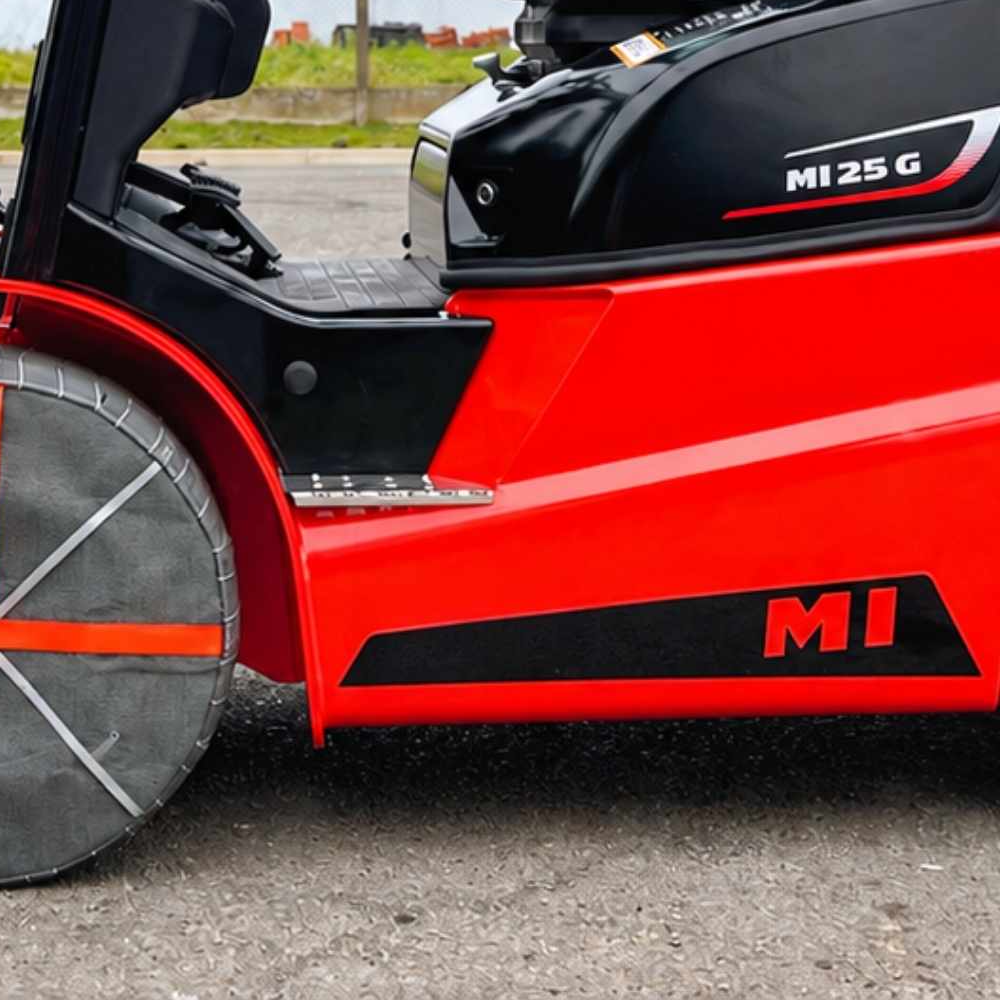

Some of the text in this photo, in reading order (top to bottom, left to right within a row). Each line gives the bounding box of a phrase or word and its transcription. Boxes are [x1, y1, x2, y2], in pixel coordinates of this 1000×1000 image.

[786, 151, 921, 192] MI 25 G
[763, 586, 898, 658] MI
